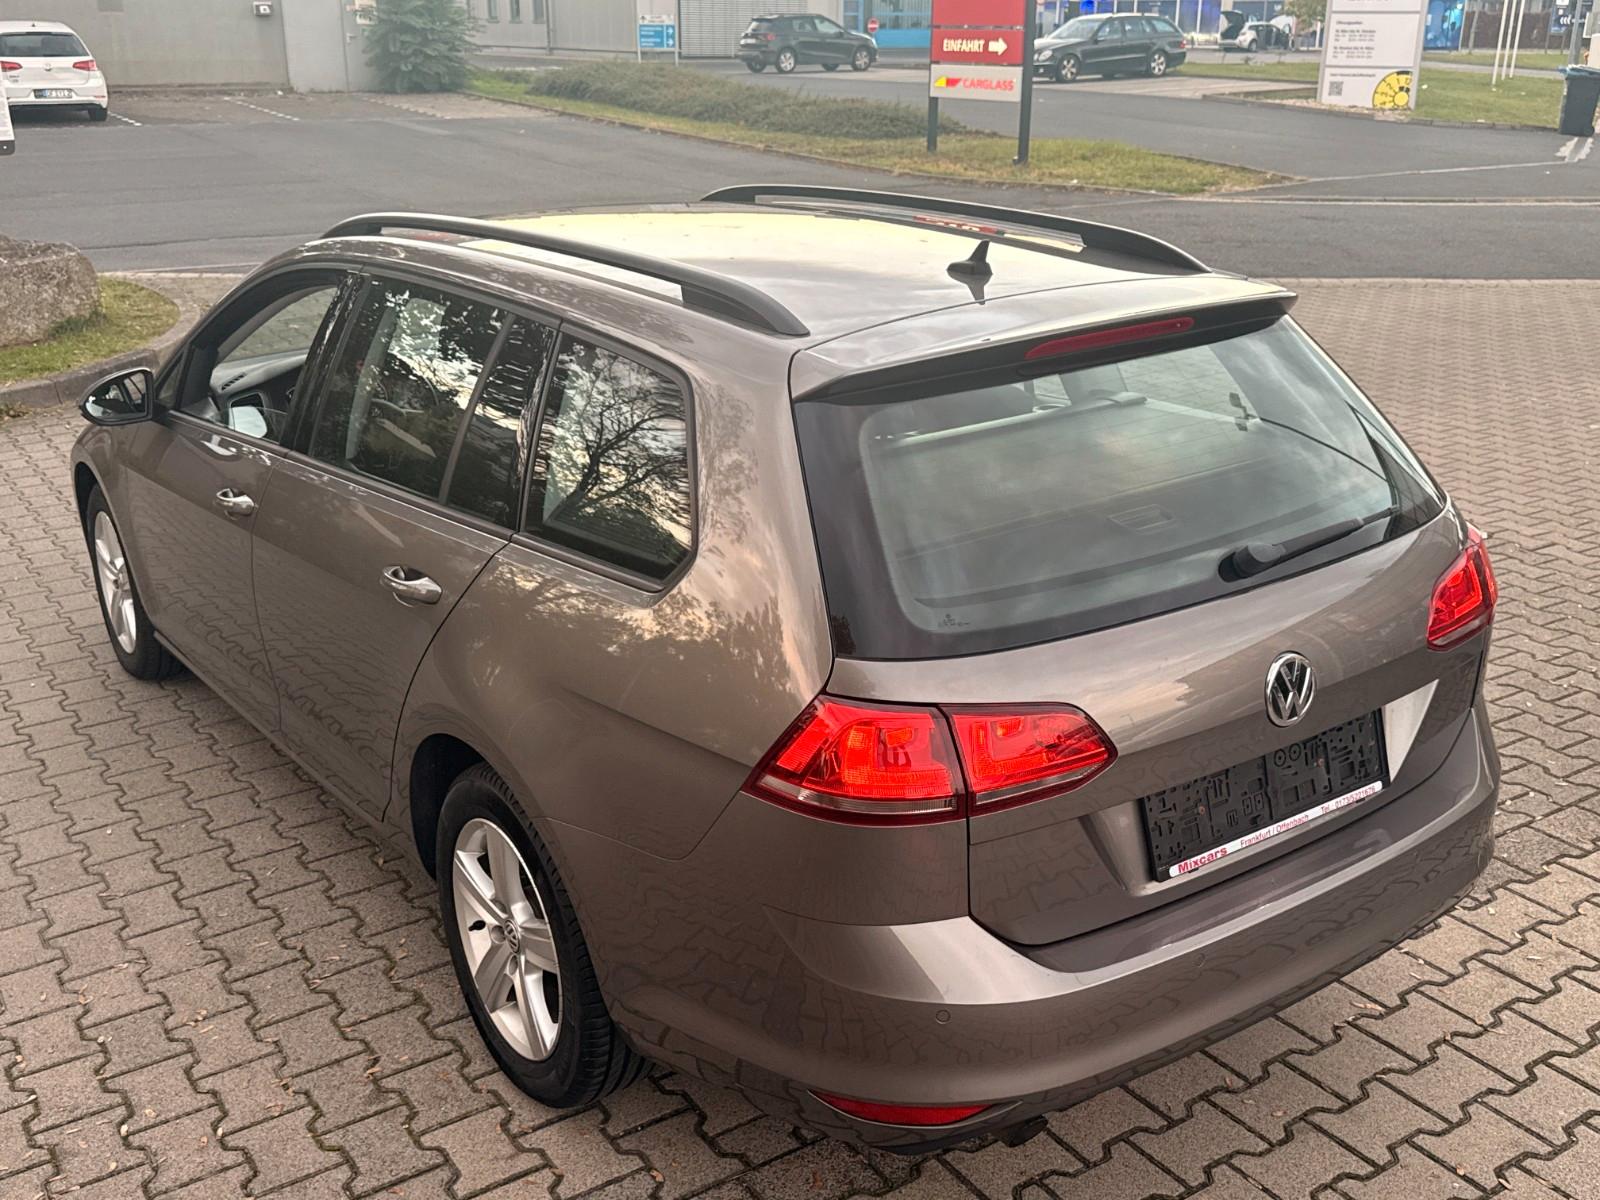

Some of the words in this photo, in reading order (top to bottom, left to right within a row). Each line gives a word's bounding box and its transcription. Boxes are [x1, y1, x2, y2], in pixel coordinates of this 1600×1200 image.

[943, 38, 985, 53] EINFAHRT
[962, 77, 1014, 91] CARGLASS
[1177, 847, 1228, 874] Mixcars
[1240, 828, 1271, 848] Frankfurt
[1276, 814, 1309, 833] Offenbach
